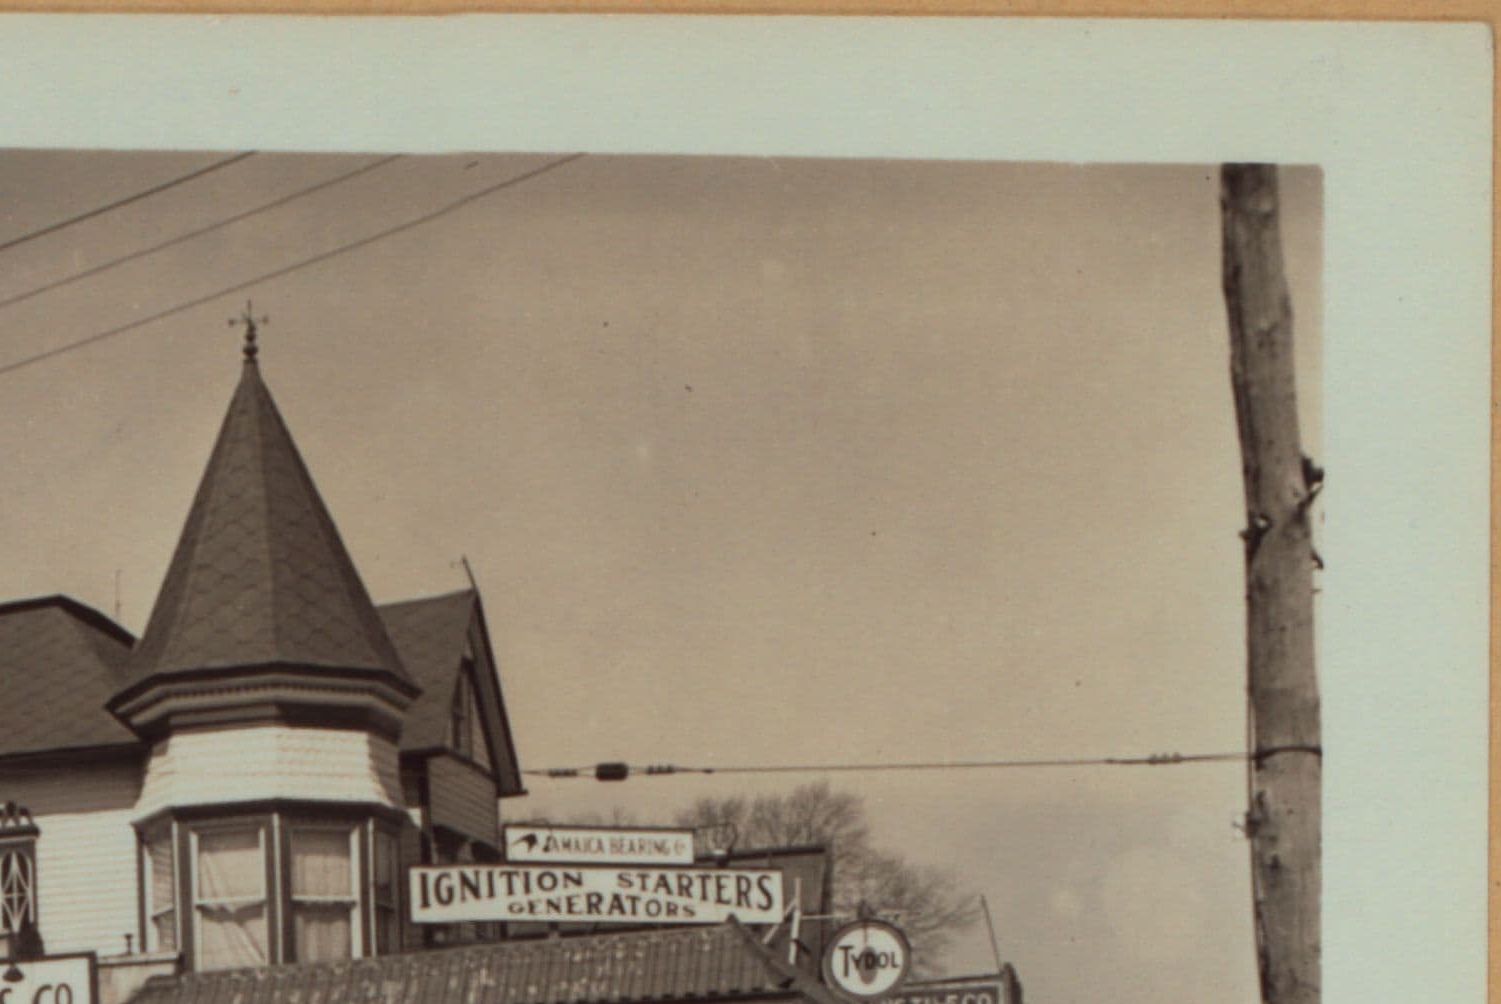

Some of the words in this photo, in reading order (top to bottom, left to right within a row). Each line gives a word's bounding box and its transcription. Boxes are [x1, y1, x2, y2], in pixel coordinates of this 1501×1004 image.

[418, 868, 585, 910] IGNITION
[616, 870, 775, 912] STARTERS
[507, 892, 697, 918] GENERATORS
[837, 944, 900, 979] TYDOL
